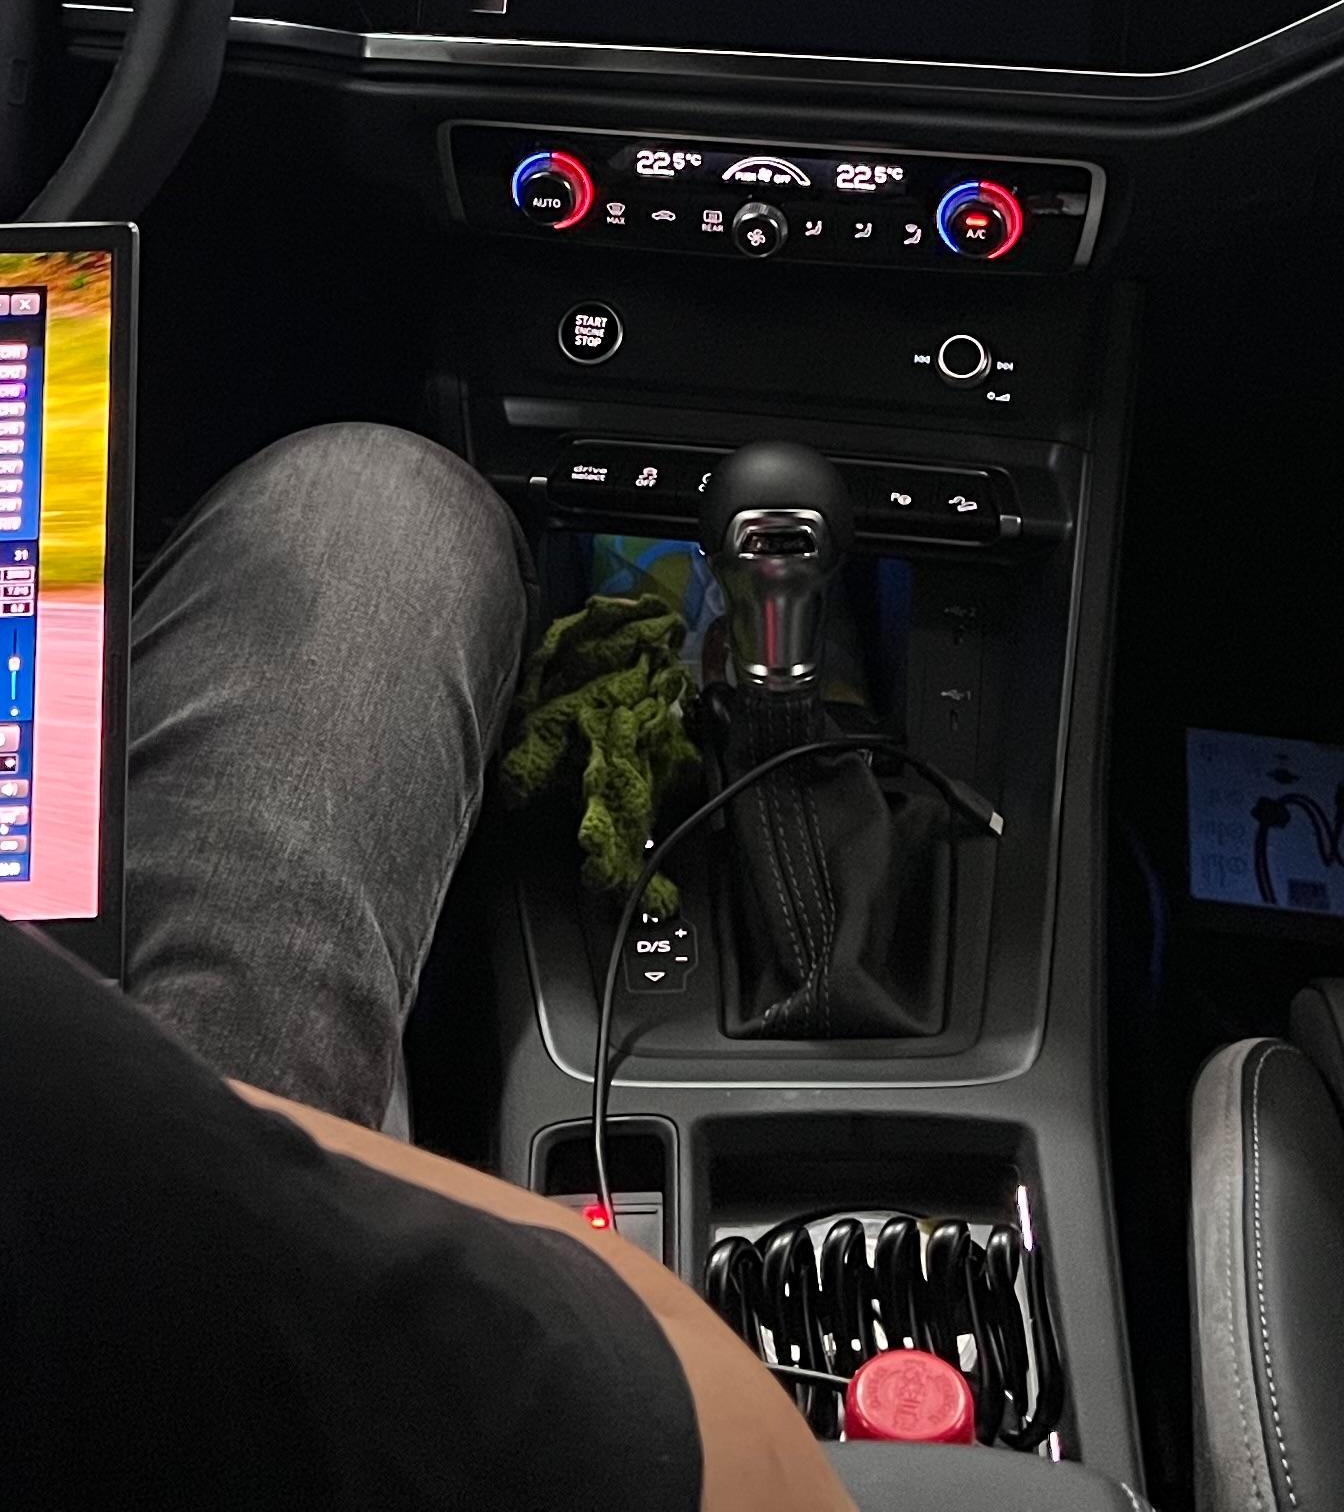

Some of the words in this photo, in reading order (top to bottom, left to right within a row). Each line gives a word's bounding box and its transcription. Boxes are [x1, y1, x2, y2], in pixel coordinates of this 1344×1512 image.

[533, 197, 561, 209] AUTO
[607, 216, 626, 225] MAX
[701, 223, 724, 233] REAR
[966, 228, 986, 240] A/C
[575, 314, 607, 328] START
[574, 334, 602, 347] STOP
[573, 465, 607, 474] drive
[636, 940, 671, 953] D/S
